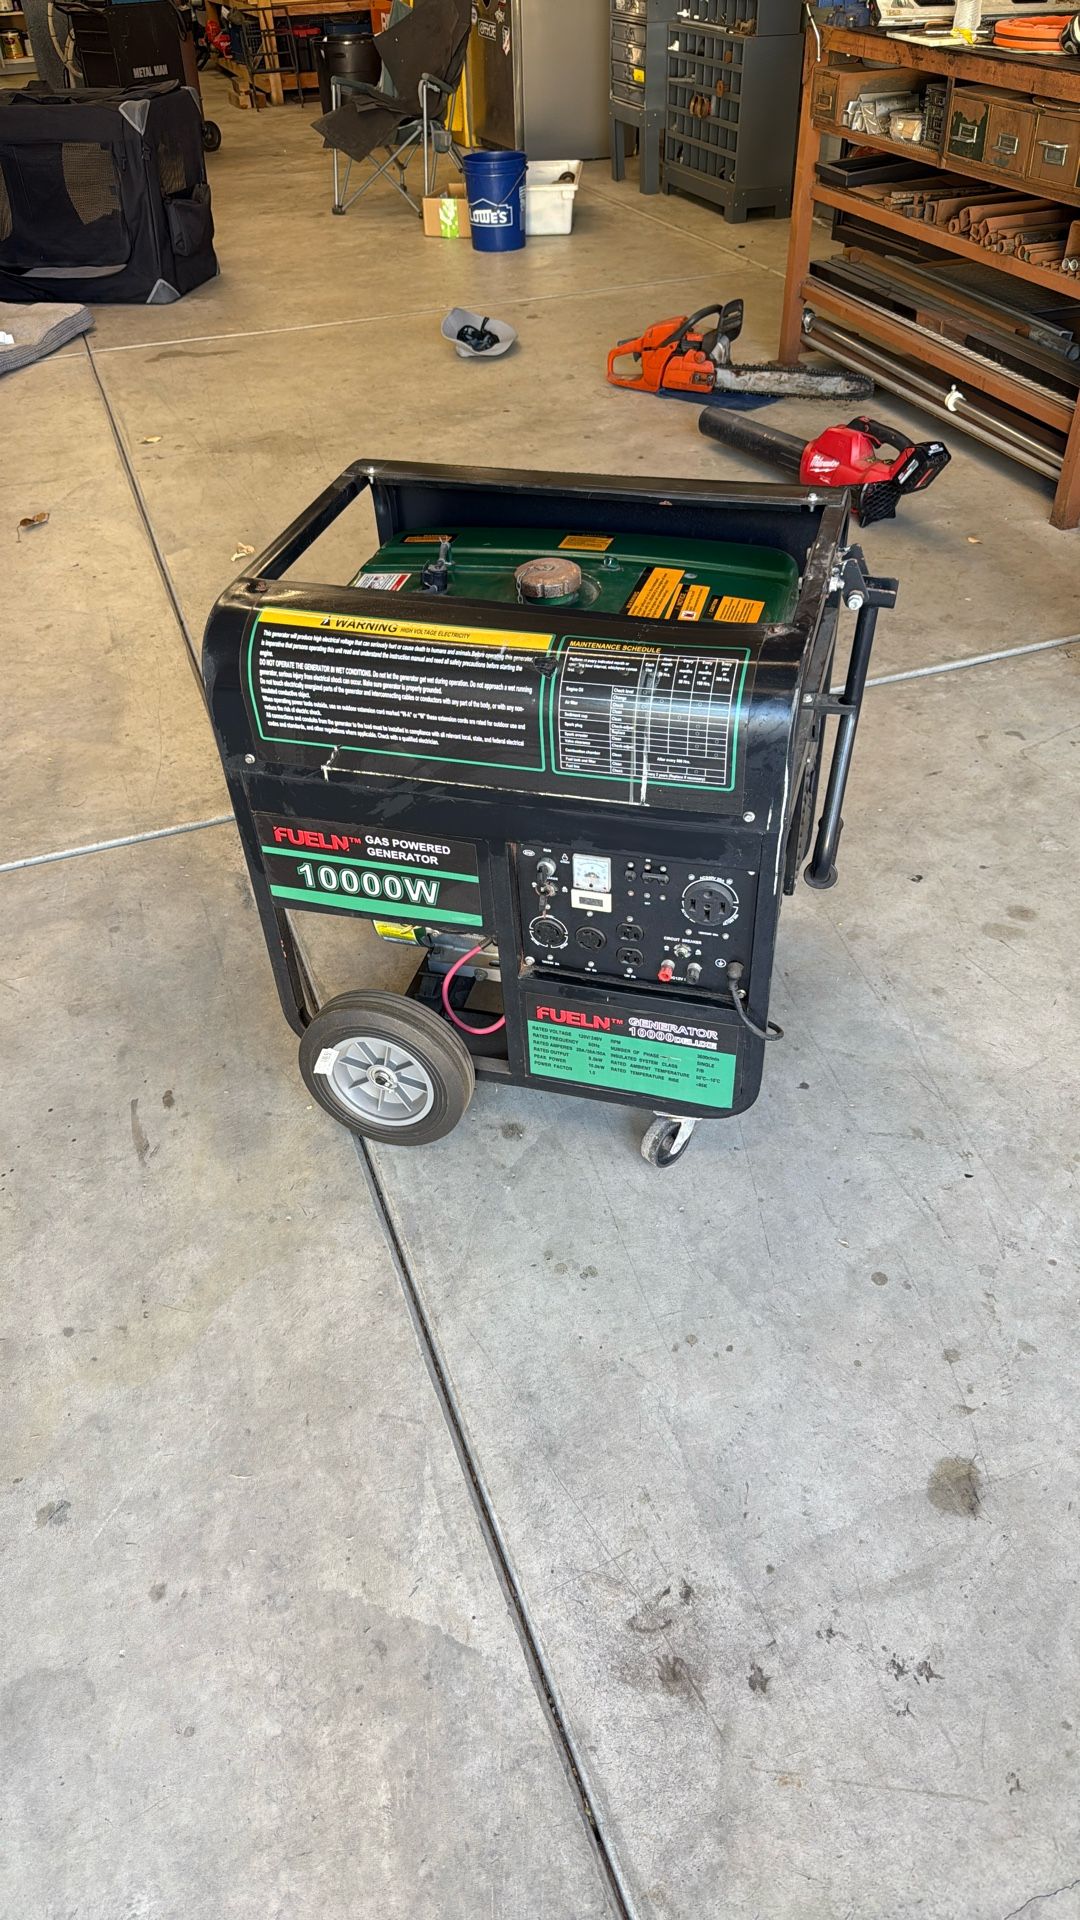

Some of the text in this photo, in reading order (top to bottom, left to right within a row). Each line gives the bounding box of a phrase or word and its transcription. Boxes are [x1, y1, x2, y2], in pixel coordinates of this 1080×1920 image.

[133, 65, 168, 78] METAL MAN
[335, 619, 398, 633] WARNING
[414, 628, 438, 636] VOLTAGE
[439, 631, 470, 639] ELECTRICITY
[570, 640, 661, 654] MAINTENANCE SCHEDULE
[365, 835, 451, 855] GAS POWERED
[367, 848, 439, 865] GENERATOR
[297, 862, 440, 905] 10000W
[628, 1017, 718, 1040] GENERATOR
